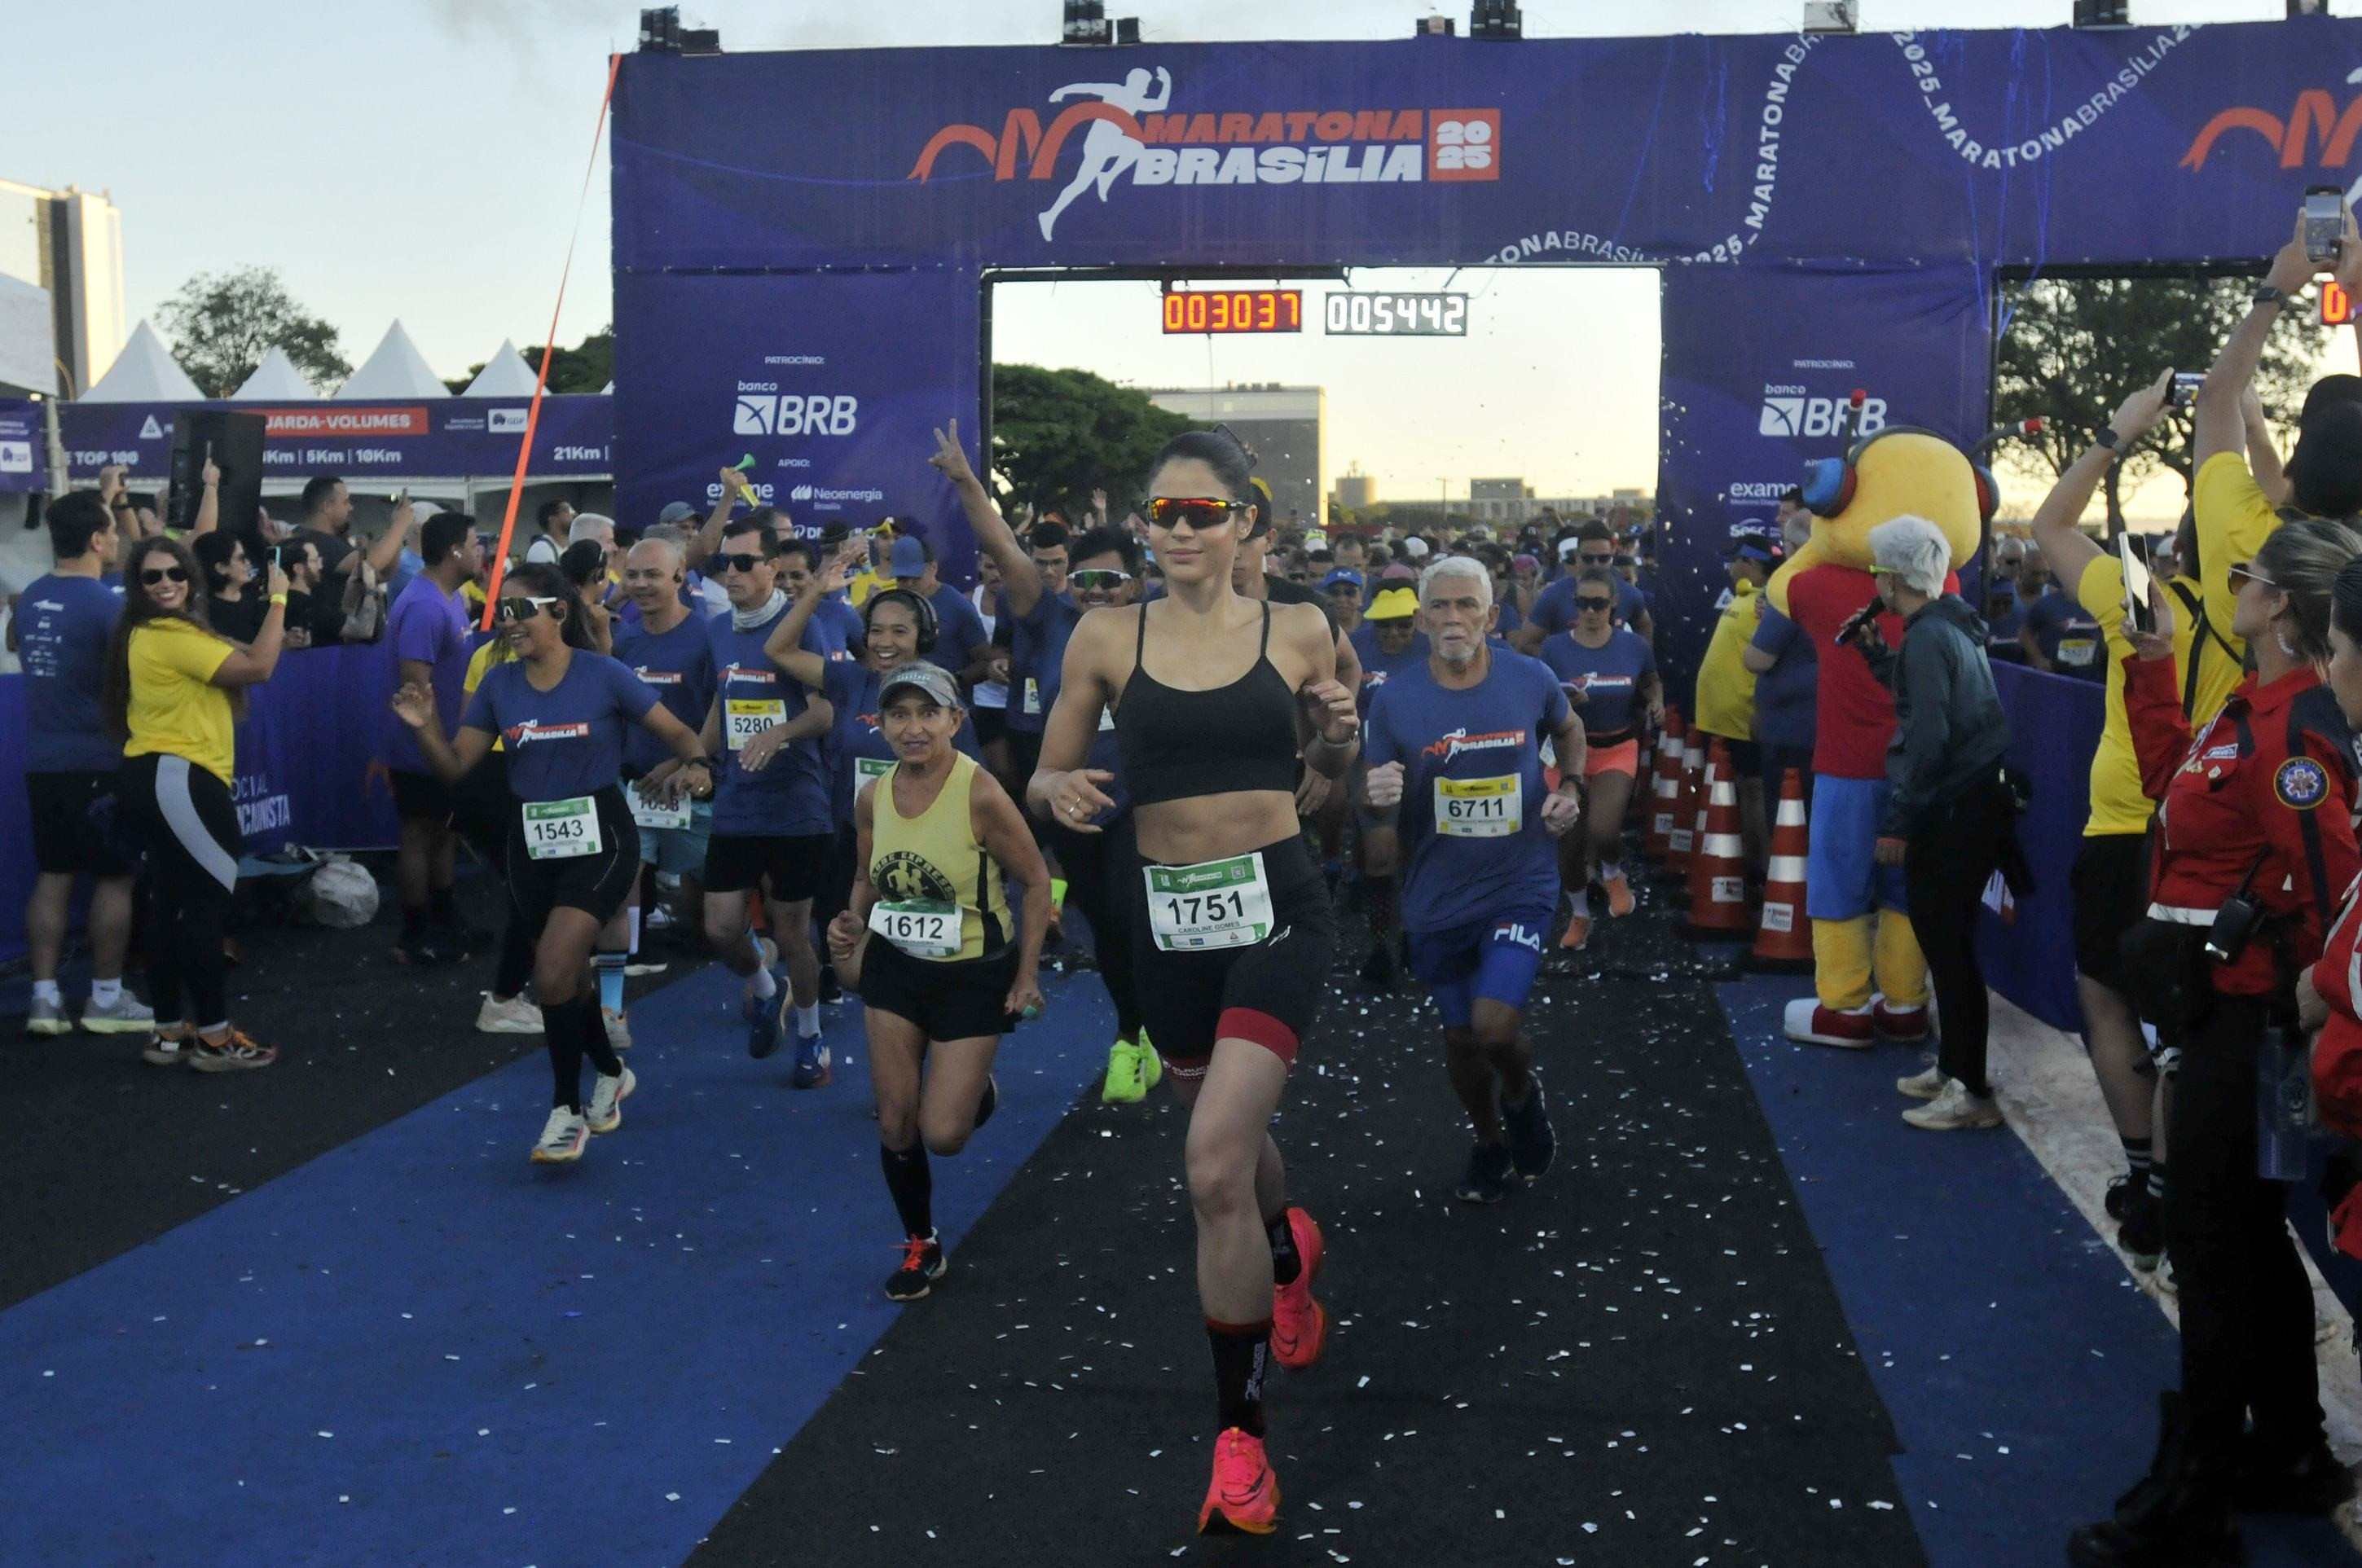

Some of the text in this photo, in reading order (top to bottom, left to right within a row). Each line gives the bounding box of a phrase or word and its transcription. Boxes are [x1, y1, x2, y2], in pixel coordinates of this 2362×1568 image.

[1144, 109, 1423, 143] MARATONA
[1133, 145, 1423, 185] BRASÍLIA
[1164, 293, 1299, 330] 003037
[1327, 295, 1464, 332] 005442
[737, 380, 778, 391] banco
[1764, 384, 1806, 395] banco
[776, 394, 858, 436] BRB
[75, 450, 108, 466] TOP
[111, 450, 139, 466] 100
[355, 448, 402, 463] 10Km
[553, 446, 600, 461] 21Km
[814, 487, 883, 503] Neoenergia
[734, 717, 773, 734] 5280
[1448, 798, 1503, 818] 6711
[534, 819, 583, 841] 1543
[1168, 890, 1244, 925] 1751
[884, 915, 943, 939] 1612
[1494, 922, 1541, 952] FILA
